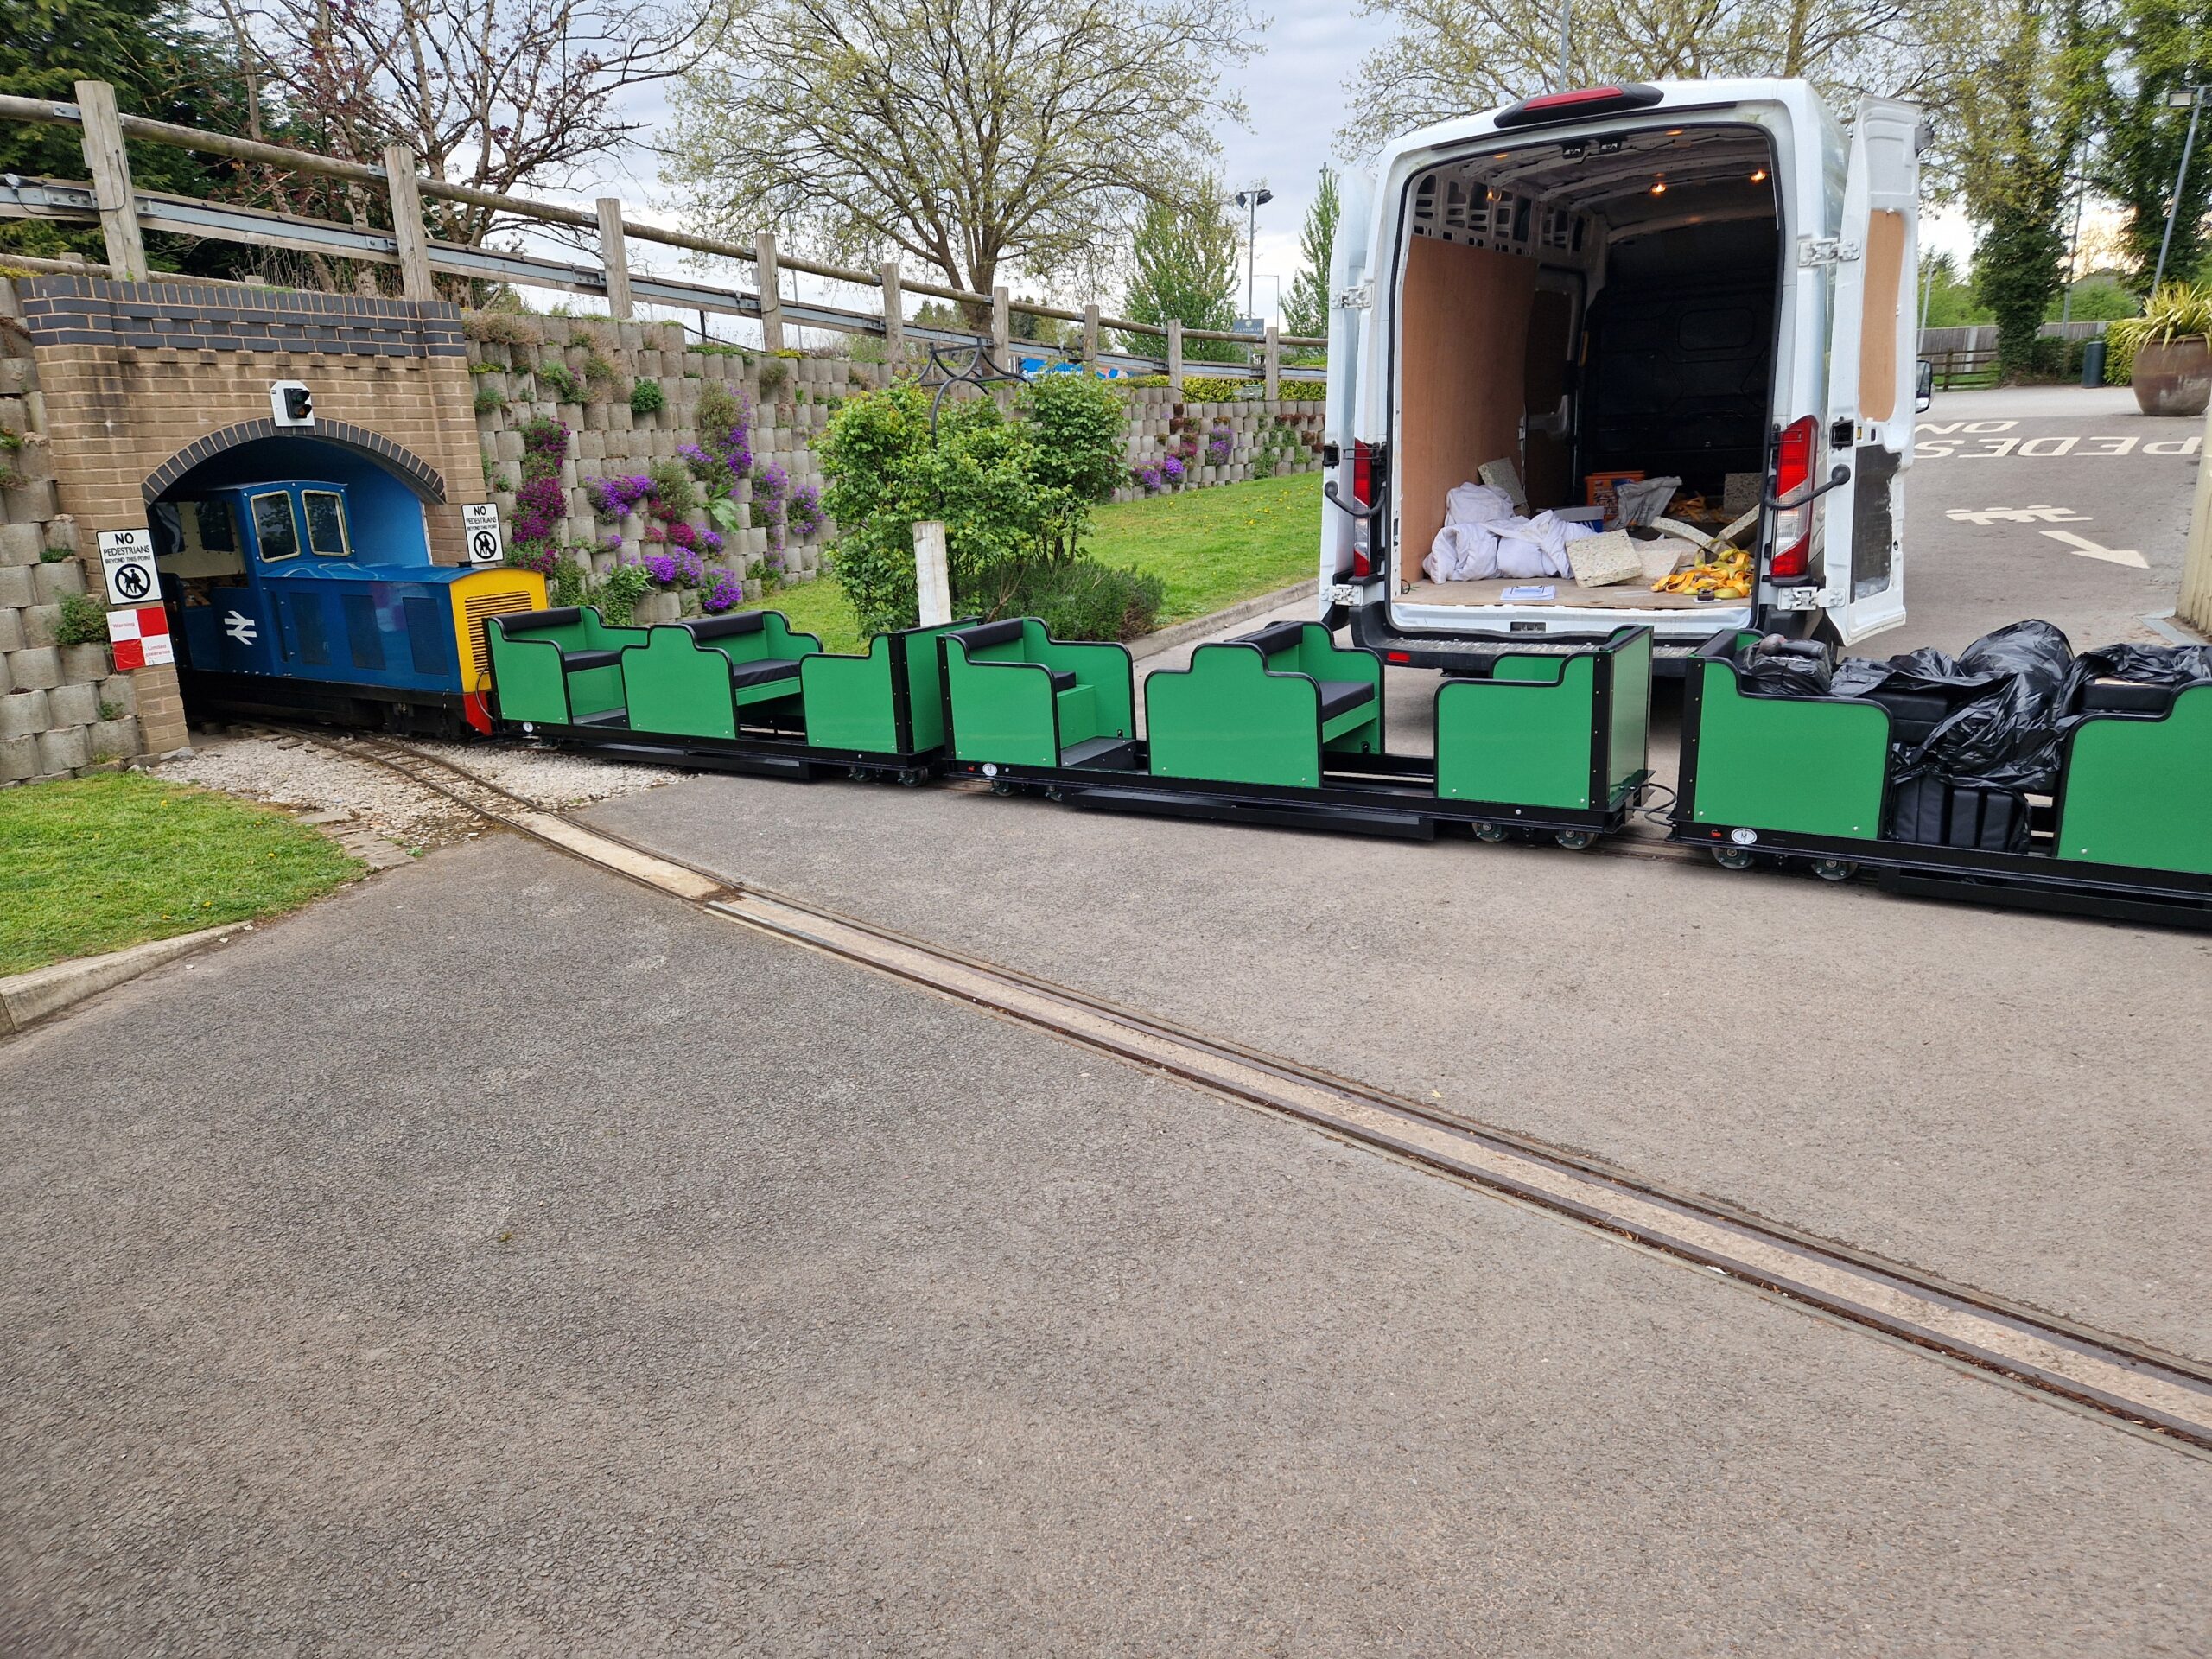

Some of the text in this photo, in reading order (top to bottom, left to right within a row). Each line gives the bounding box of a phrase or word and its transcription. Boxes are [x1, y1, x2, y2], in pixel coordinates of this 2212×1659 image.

[473, 505, 486, 516] NO
[114, 532, 134, 545] NO
[103, 545, 150, 556] PEDESTRIANS
